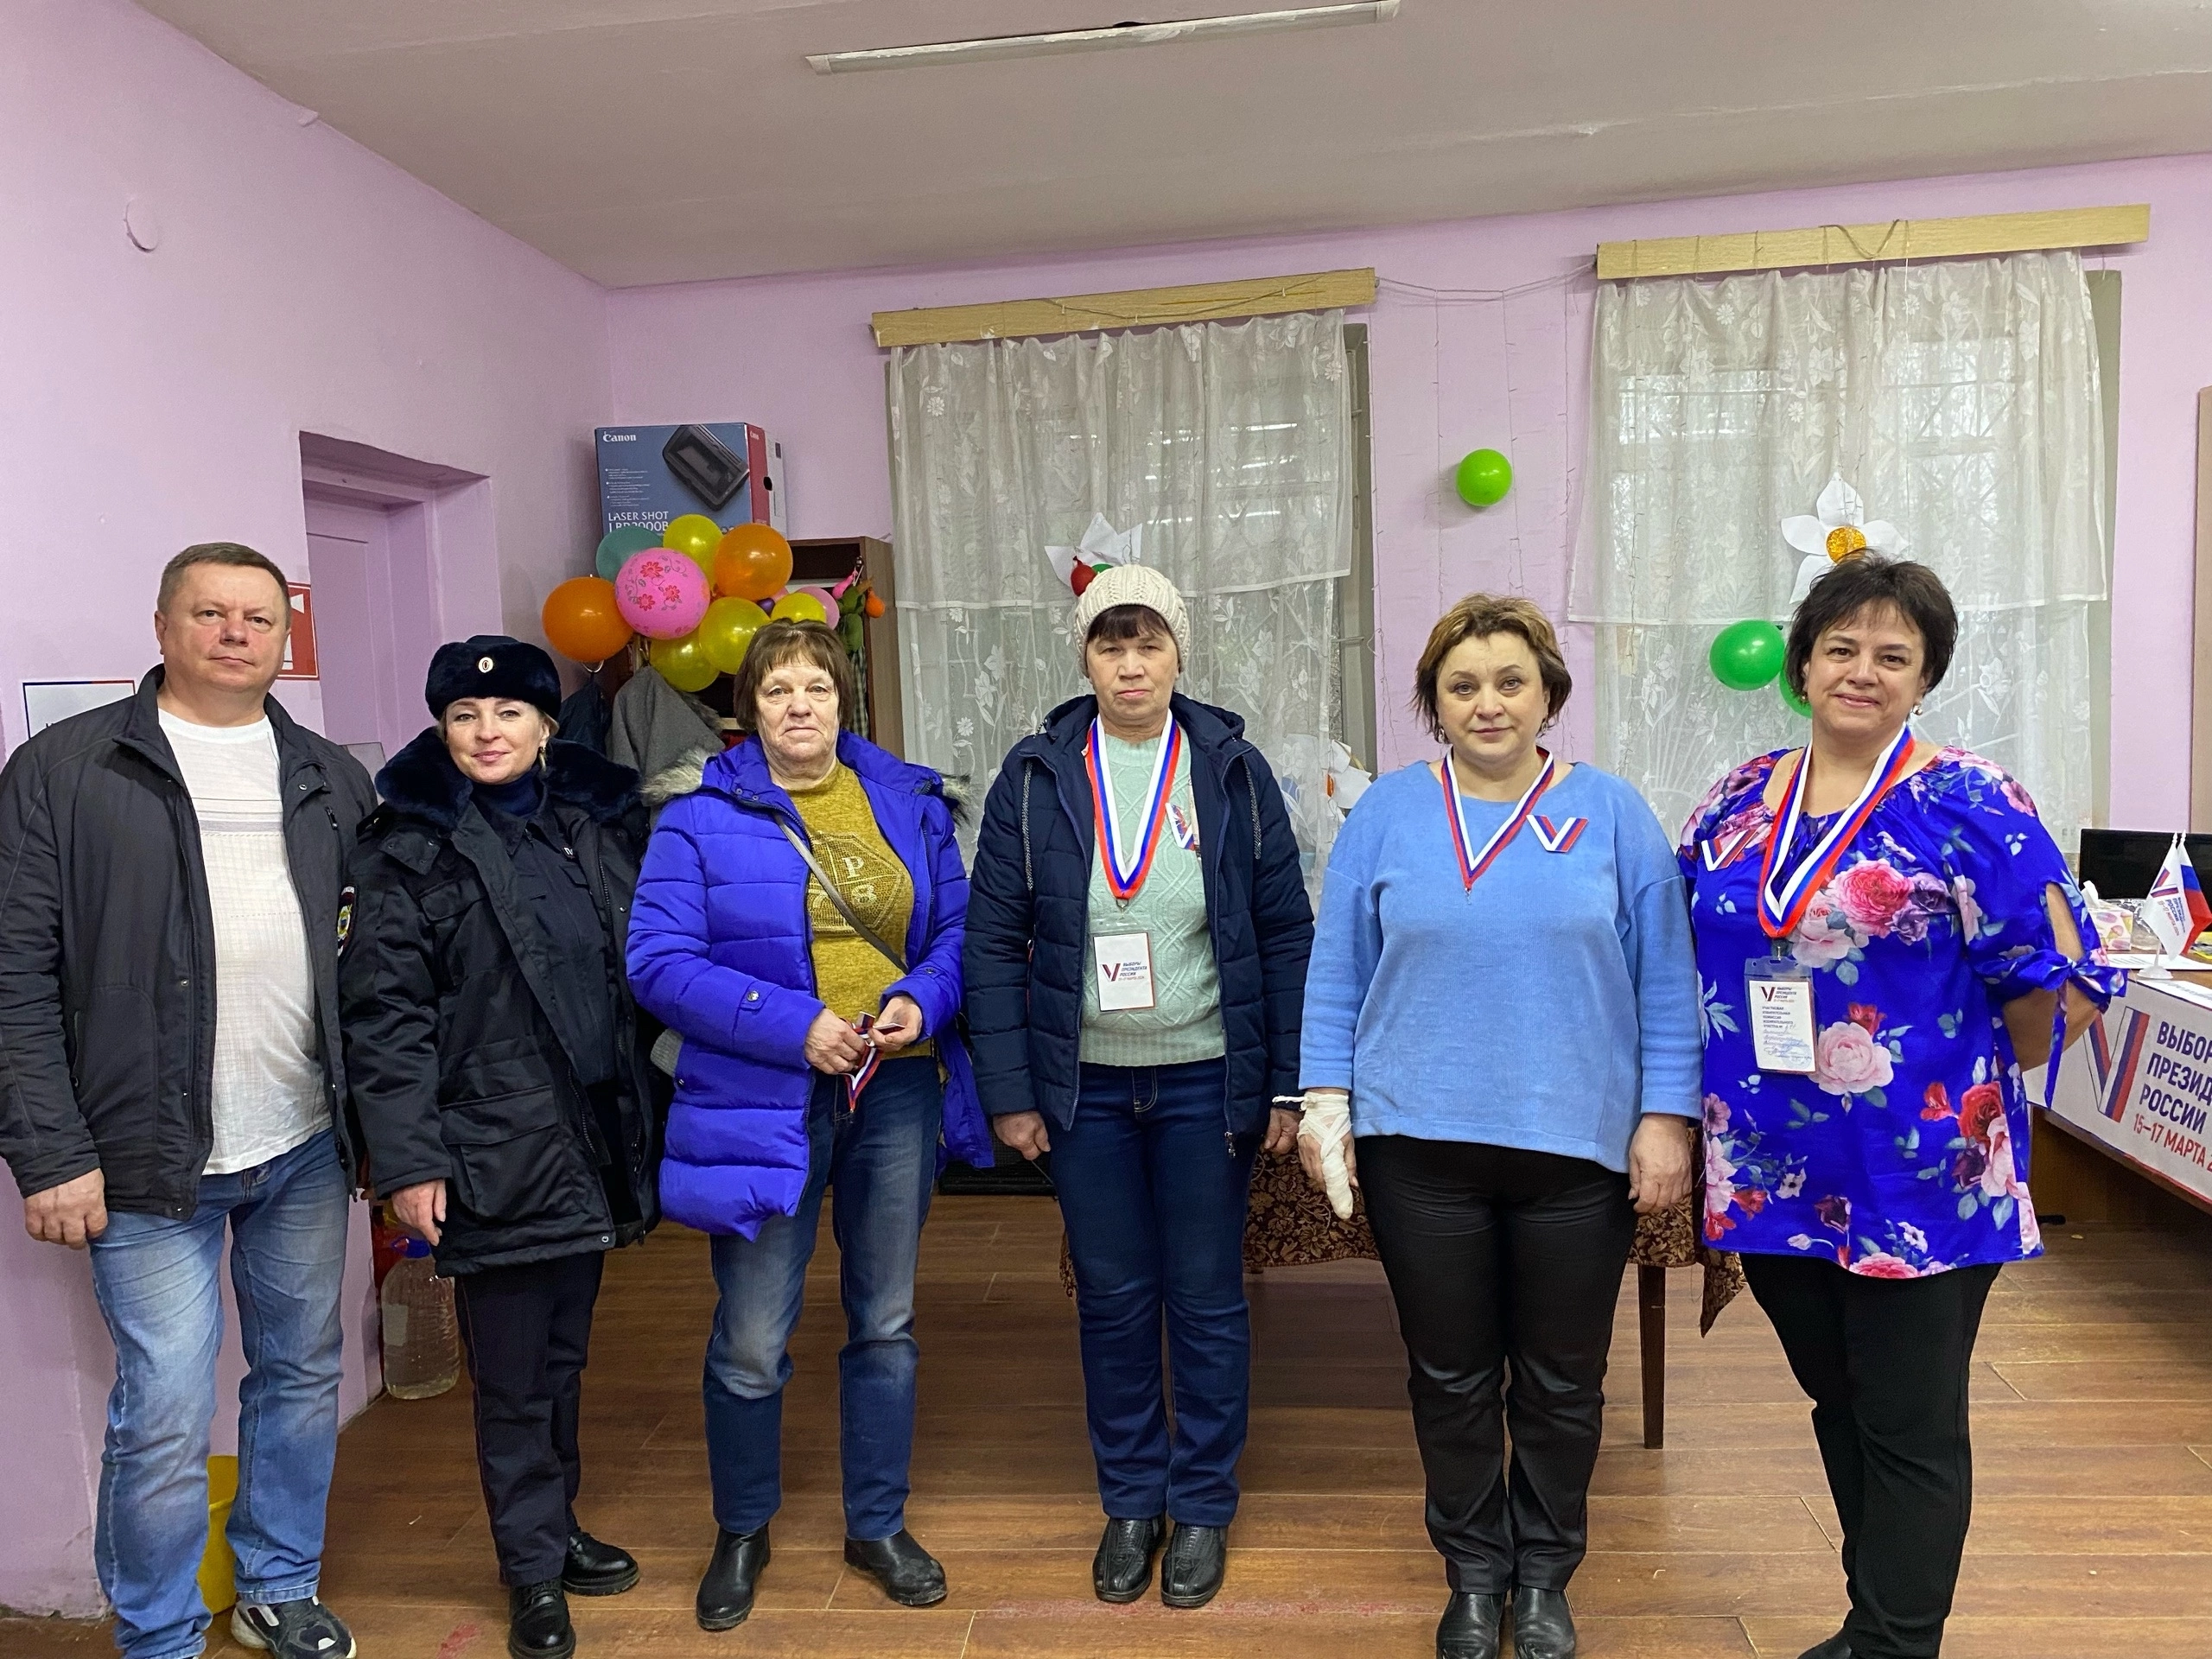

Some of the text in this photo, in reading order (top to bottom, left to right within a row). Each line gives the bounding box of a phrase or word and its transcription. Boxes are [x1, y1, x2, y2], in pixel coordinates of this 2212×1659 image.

[603, 431, 637, 442] Canon
[608, 511, 669, 521] LASER SHOT
[2139, 1083, 2208, 1135] РОССИИ
[2164, 1128, 2207, 1167] МАРТА
